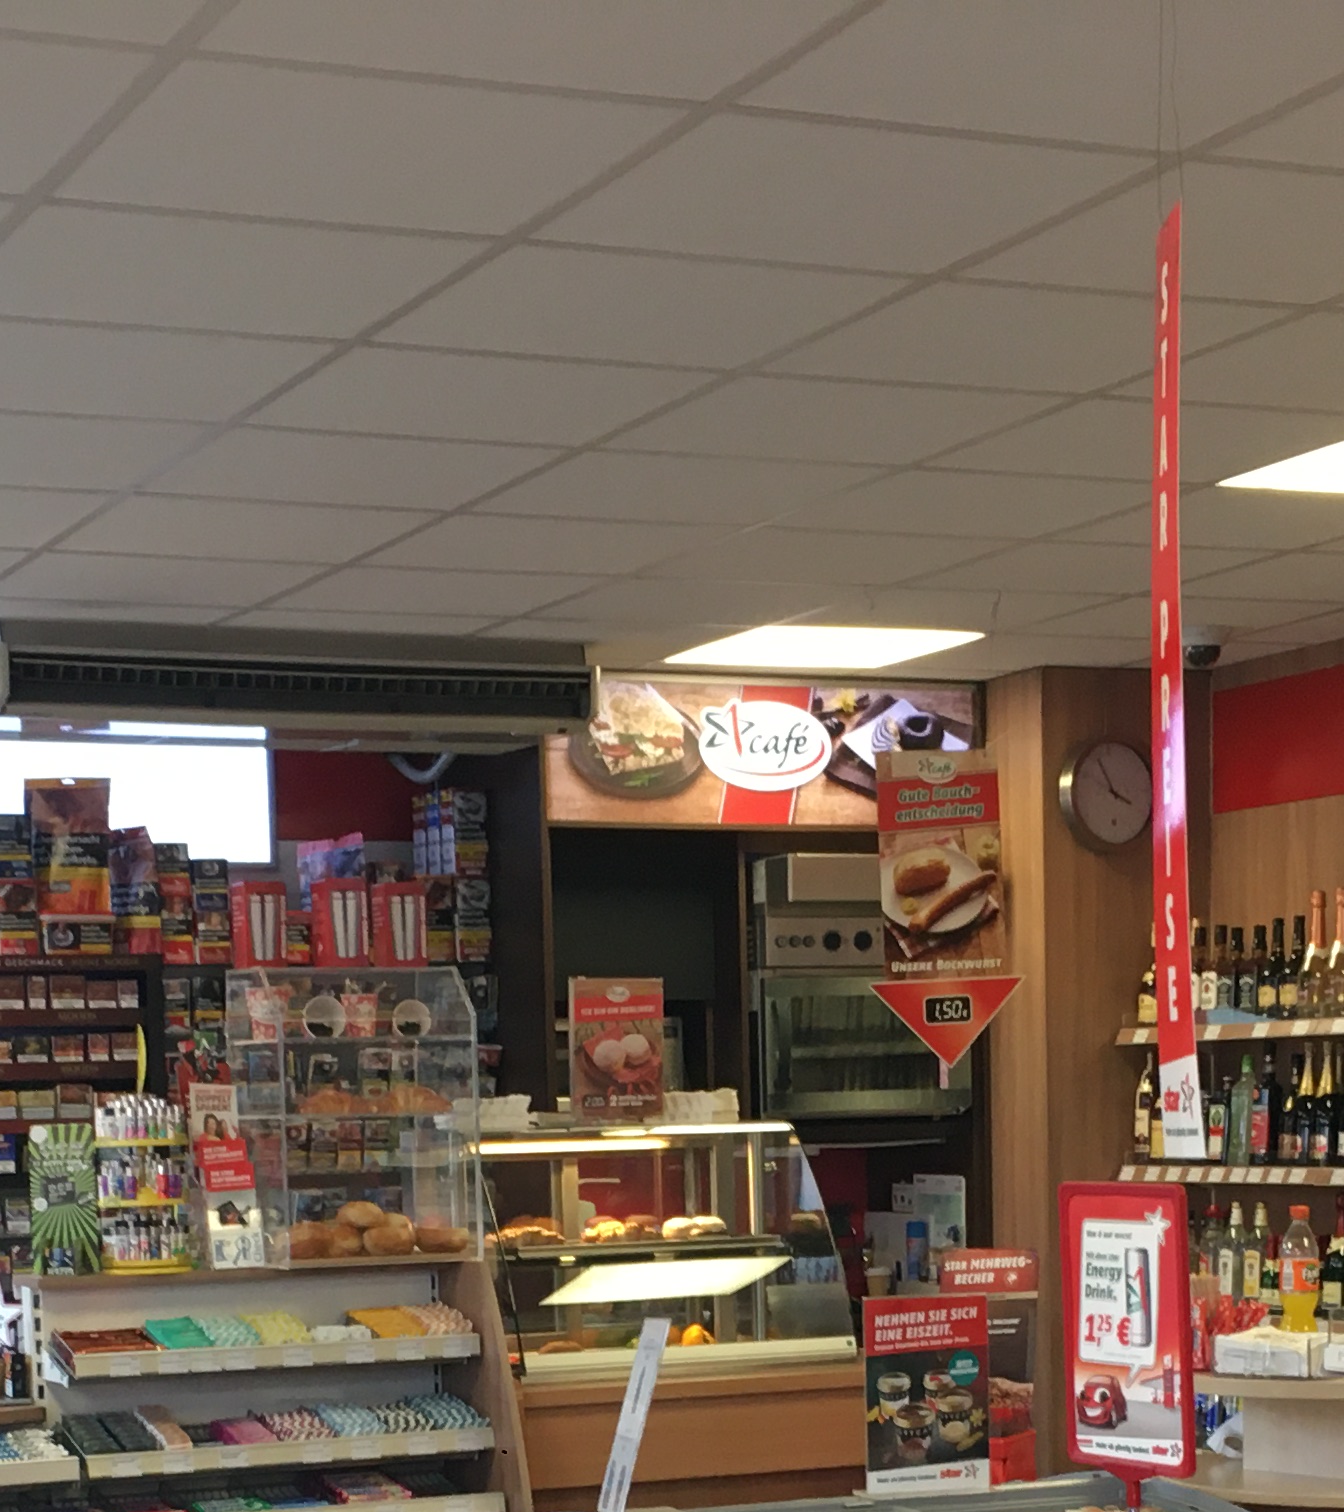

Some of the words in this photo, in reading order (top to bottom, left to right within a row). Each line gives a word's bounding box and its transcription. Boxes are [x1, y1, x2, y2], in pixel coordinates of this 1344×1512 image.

[898, 786, 931, 804] Gute
[932, 782, 981, 802] Bauch-
[895, 803, 985, 823] entscheidung
[1085, 1262, 1123, 1284] Energy
[874, 1311, 925, 1328] NEHMEN
[927, 1309, 948, 1322] SIE
[949, 1306, 979, 1322] SICH
[874, 1328, 904, 1343] EINE
[905, 1323, 954, 1340] EISZEIT.
[1116, 1316, 1132, 1347] €
